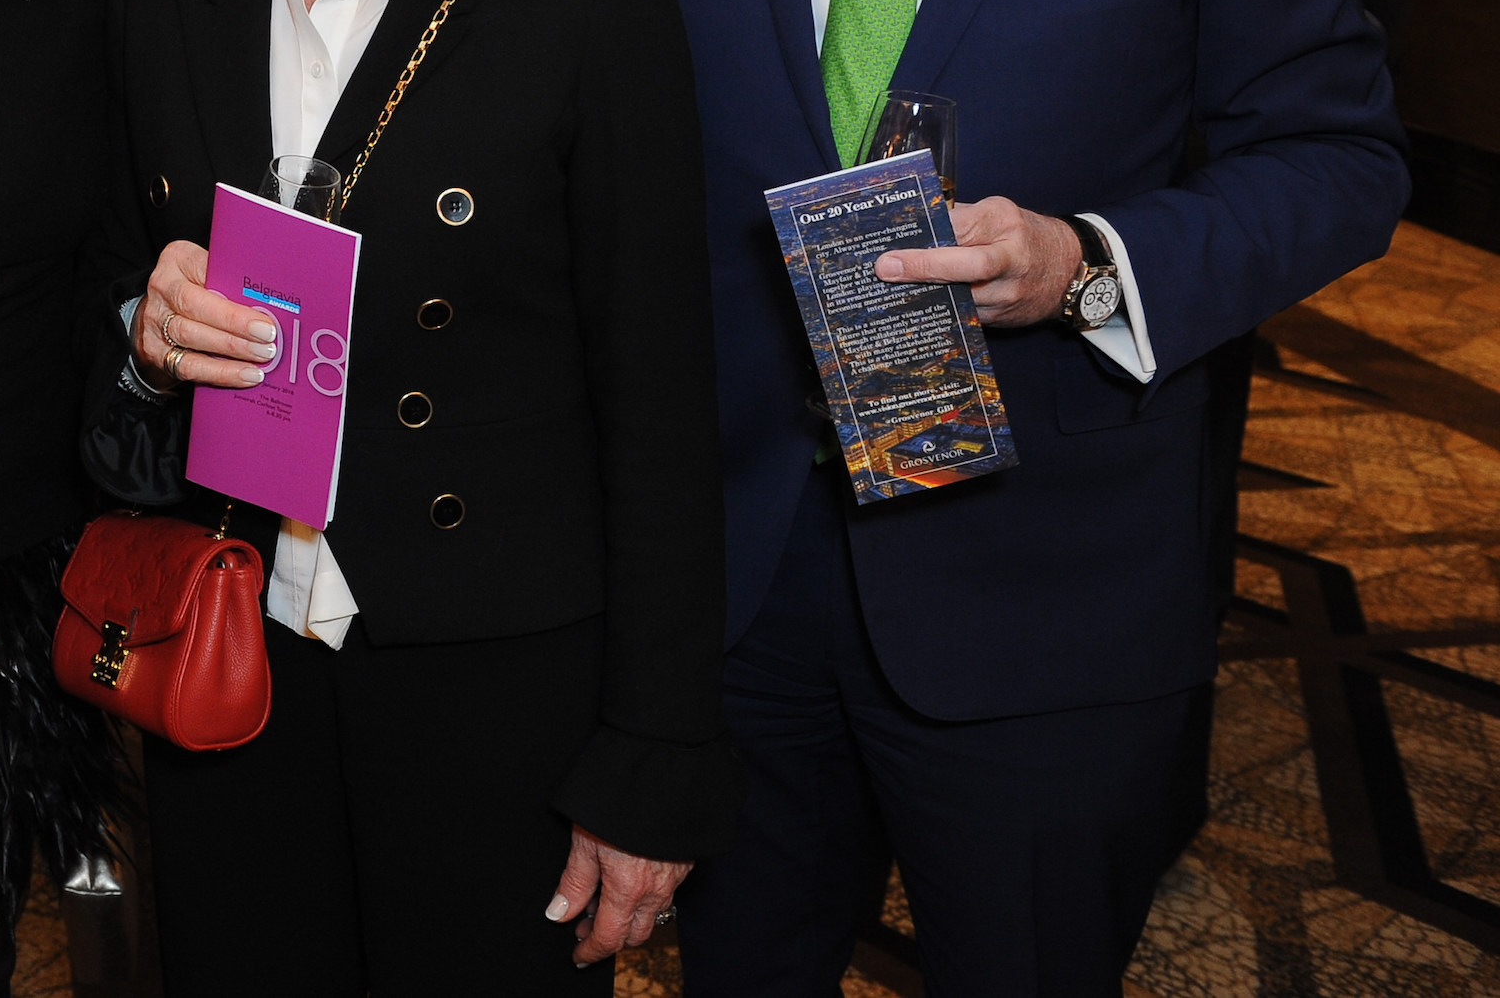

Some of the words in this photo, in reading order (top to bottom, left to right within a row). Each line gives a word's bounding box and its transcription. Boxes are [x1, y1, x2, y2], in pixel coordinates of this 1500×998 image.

[799, 212, 826, 225] Our
[827, 205, 843, 218] 20
[843, 200, 875, 214] Year
[875, 190, 917, 206] Vision
[833, 244, 860, 254] Always
[895, 228, 922, 239] Always
[865, 222, 918, 239] ever-changing
[818, 265, 862, 280] Grosvenor's
[823, 275, 853, 286] Mayfair
[854, 271, 861, 279] &
[243, 276, 301, 305] Belgravia
[822, 283, 853, 293] together
[855, 276, 872, 286] with
[858, 283, 886, 294] playing
[827, 302, 863, 314] becoming
[864, 297, 883, 306] more
[909, 286, 927, 295] open
[847, 288, 889, 303] remarkable
[269, 299, 300, 314] AWARDS
[836, 326, 854, 335] This
[869, 316, 900, 326] singular
[901, 309, 924, 319] vision
[924, 305, 933, 313] of
[933, 303, 946, 311] the
[836, 333, 860, 342] future
[861, 327, 878, 336] that
[878, 324, 892, 332] can
[892, 320, 910, 328] only
[921, 309, 951, 322] realised
[839, 336, 869, 348] through
[921, 319, 953, 329] evolving
[844, 344, 874, 354] Mayfair
[883, 333, 919, 345] Belgravia
[920, 326, 951, 337] together
[849, 360, 867, 369] This
[881, 348, 917, 360] challenge
[855, 351, 872, 360] with
[873, 346, 895, 355] many
[858, 362, 892, 373] challenge
[894, 356, 910, 365] that
[911, 352, 934, 362] starts
[868, 400, 880, 408] To
[880, 395, 897, 405] find
[898, 392, 913, 401] out
[939, 382, 960, 391] visit:
[900, 449, 964, 469] GROSVENOR
